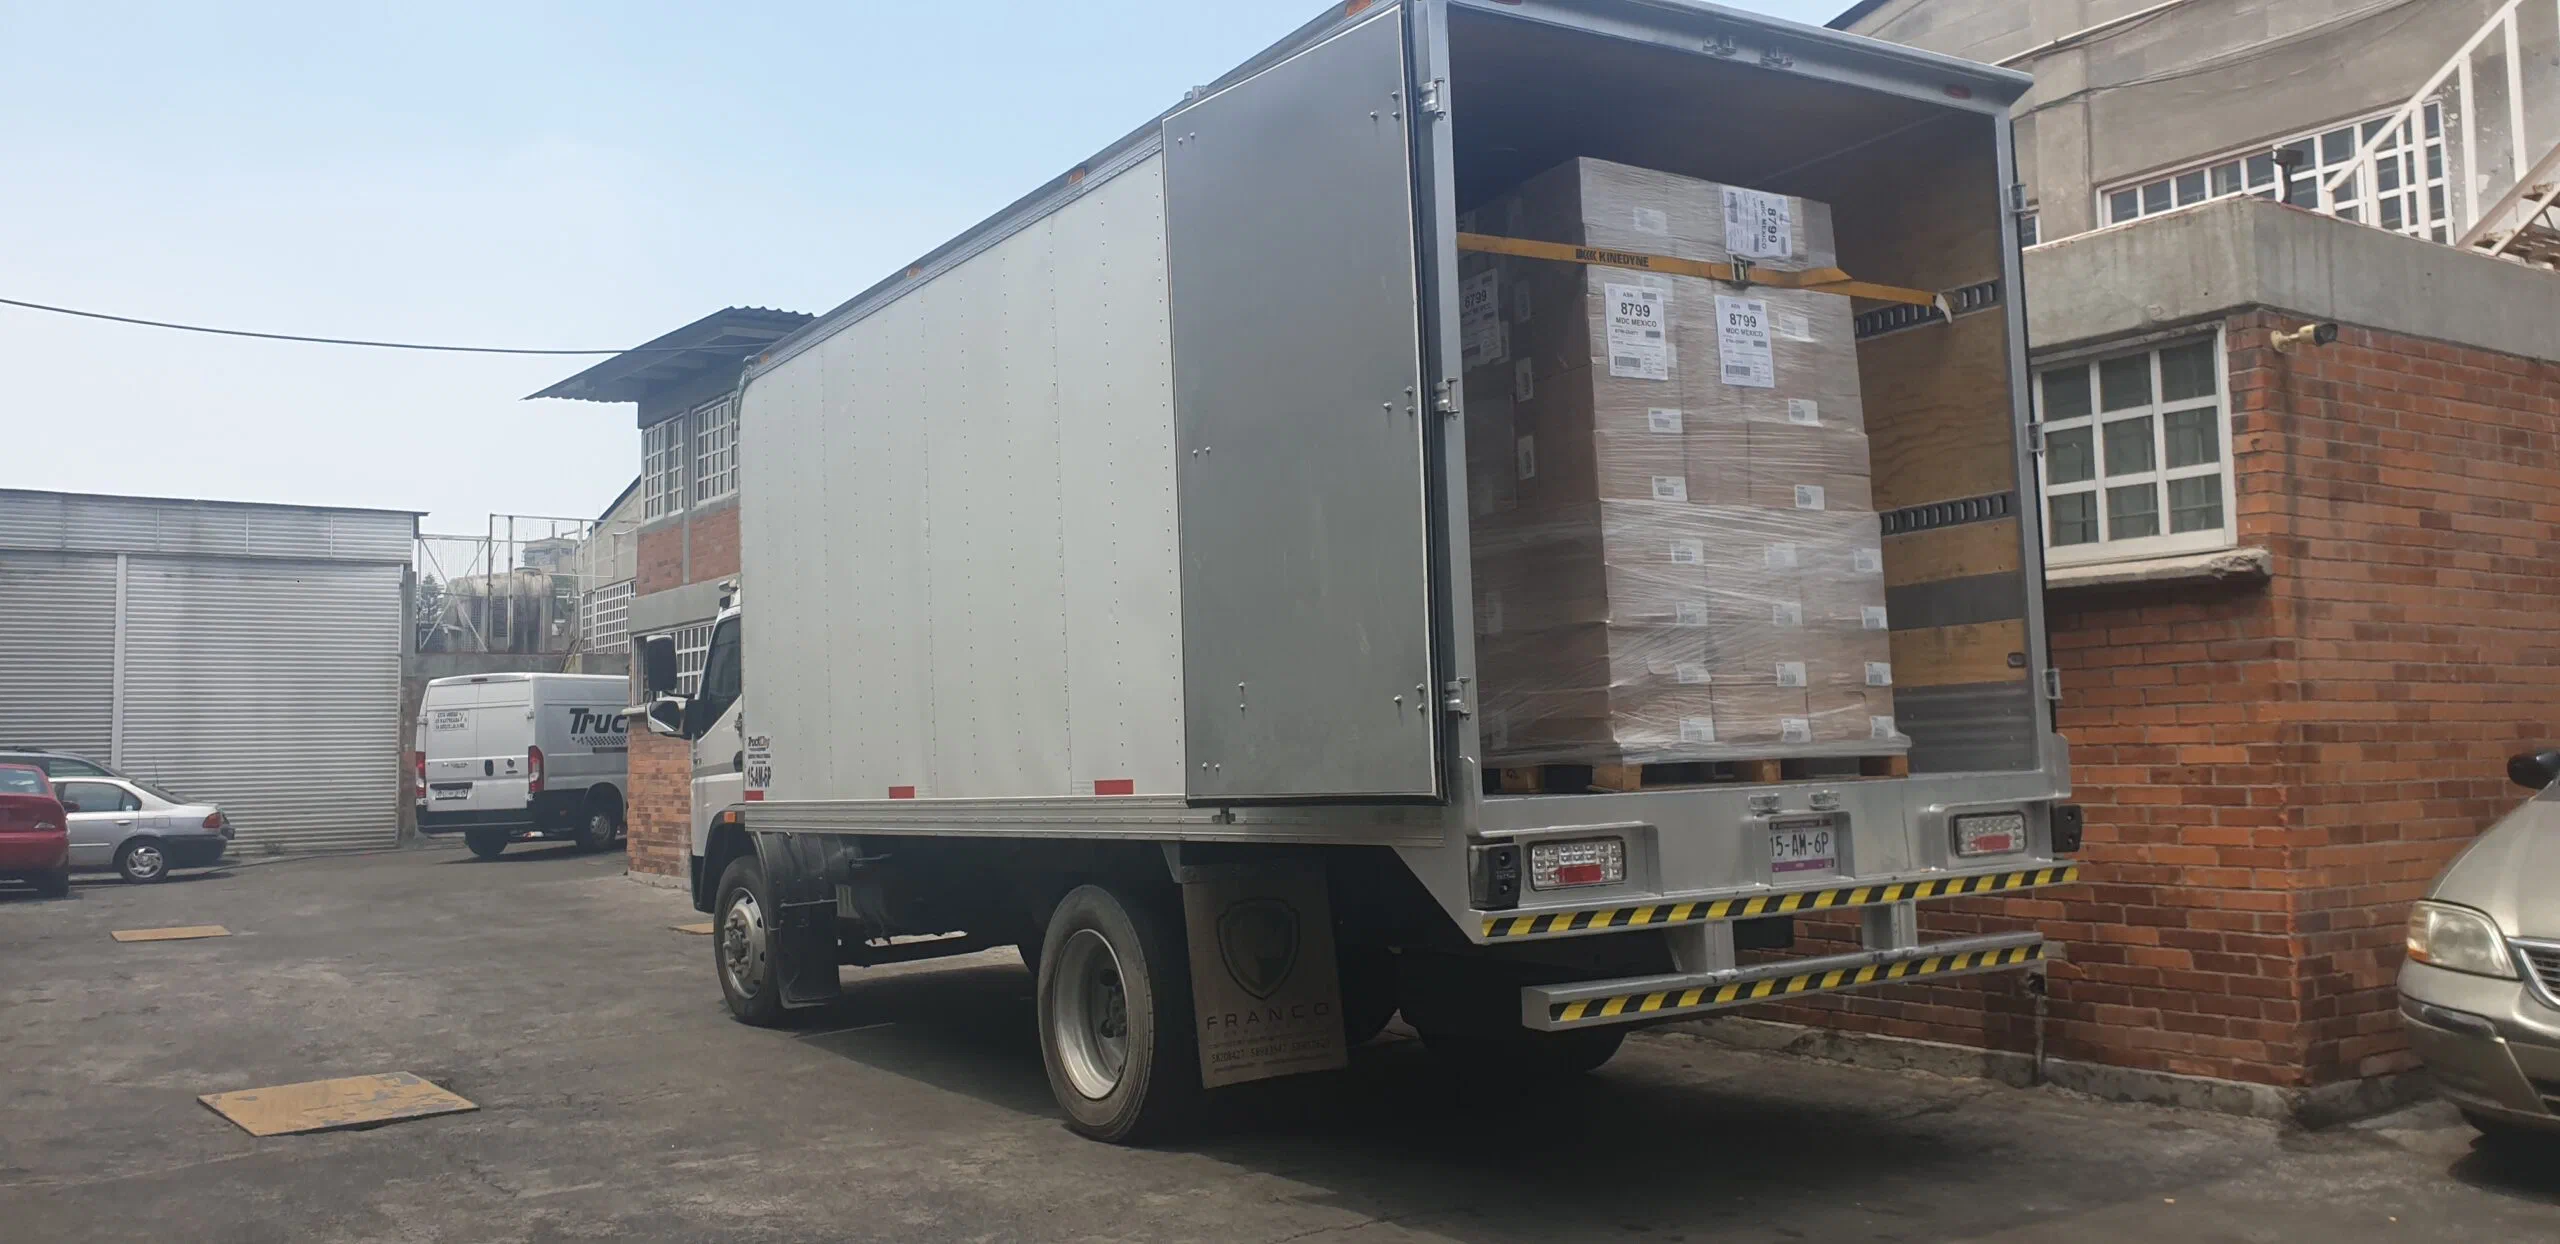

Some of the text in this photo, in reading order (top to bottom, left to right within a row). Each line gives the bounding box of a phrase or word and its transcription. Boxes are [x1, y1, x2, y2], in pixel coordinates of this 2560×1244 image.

[1767, 207, 1778, 243] 8799
[1599, 251, 1649, 267] KINEDYNE
[1620, 302, 1650, 318] 8799
[1615, 317, 1657, 328] MDC MEXICO
[1729, 313, 1757, 328] 8799
[1725, 327, 1764, 337] MDC MEXICO
[569, 707, 629, 734] Truc
[1770, 832, 1829, 857] 15-AM-6P
[1207, 1002, 1329, 1030] FRANCO
